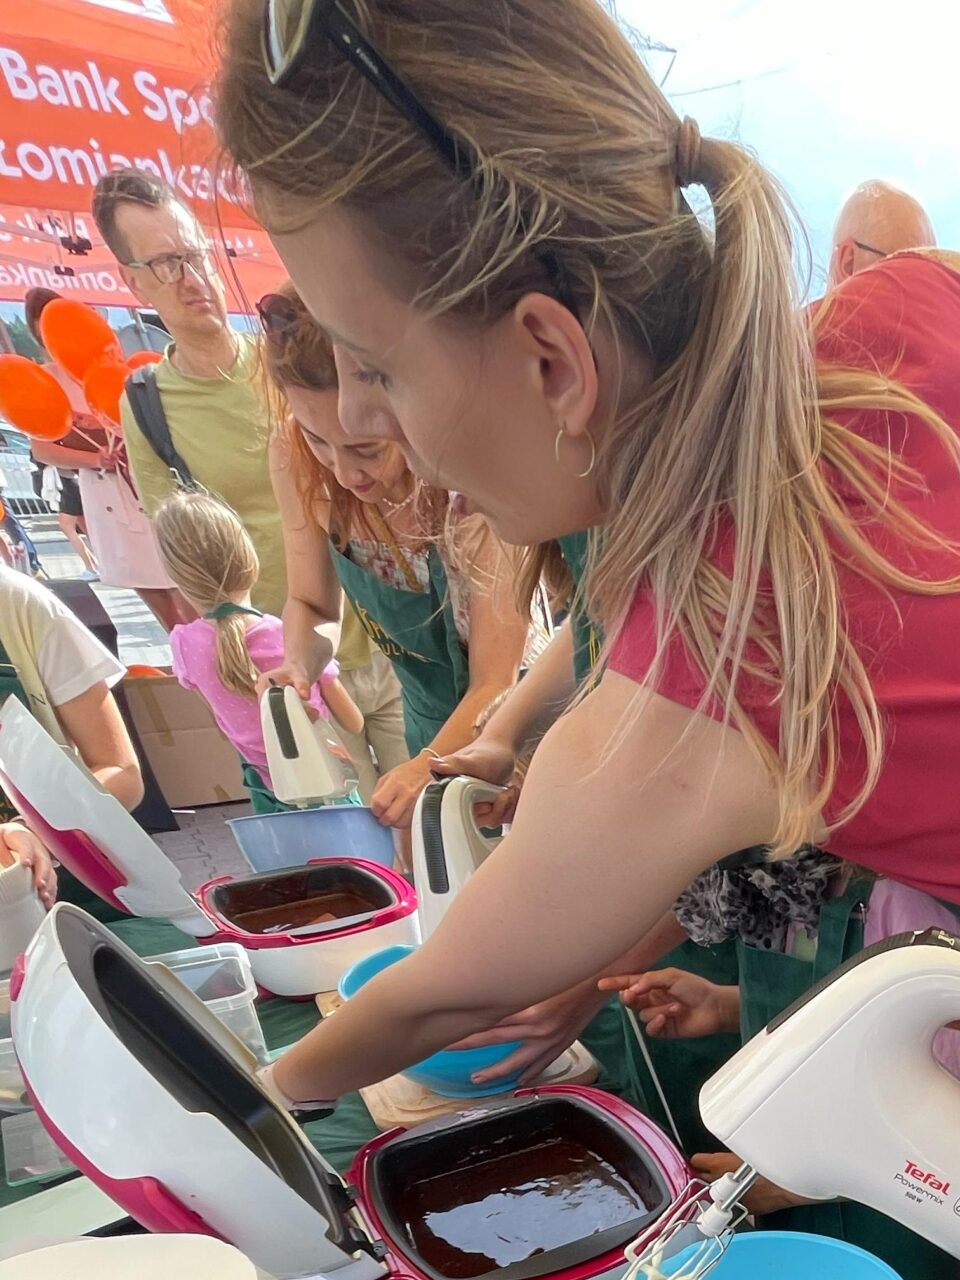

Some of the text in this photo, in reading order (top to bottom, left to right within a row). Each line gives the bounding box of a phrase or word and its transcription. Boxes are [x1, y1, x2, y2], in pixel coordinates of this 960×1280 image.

[0, 47, 130, 117] Bank
[894, 1173, 945, 1206] Powermix
[904, 1159, 951, 1196] Tefal
